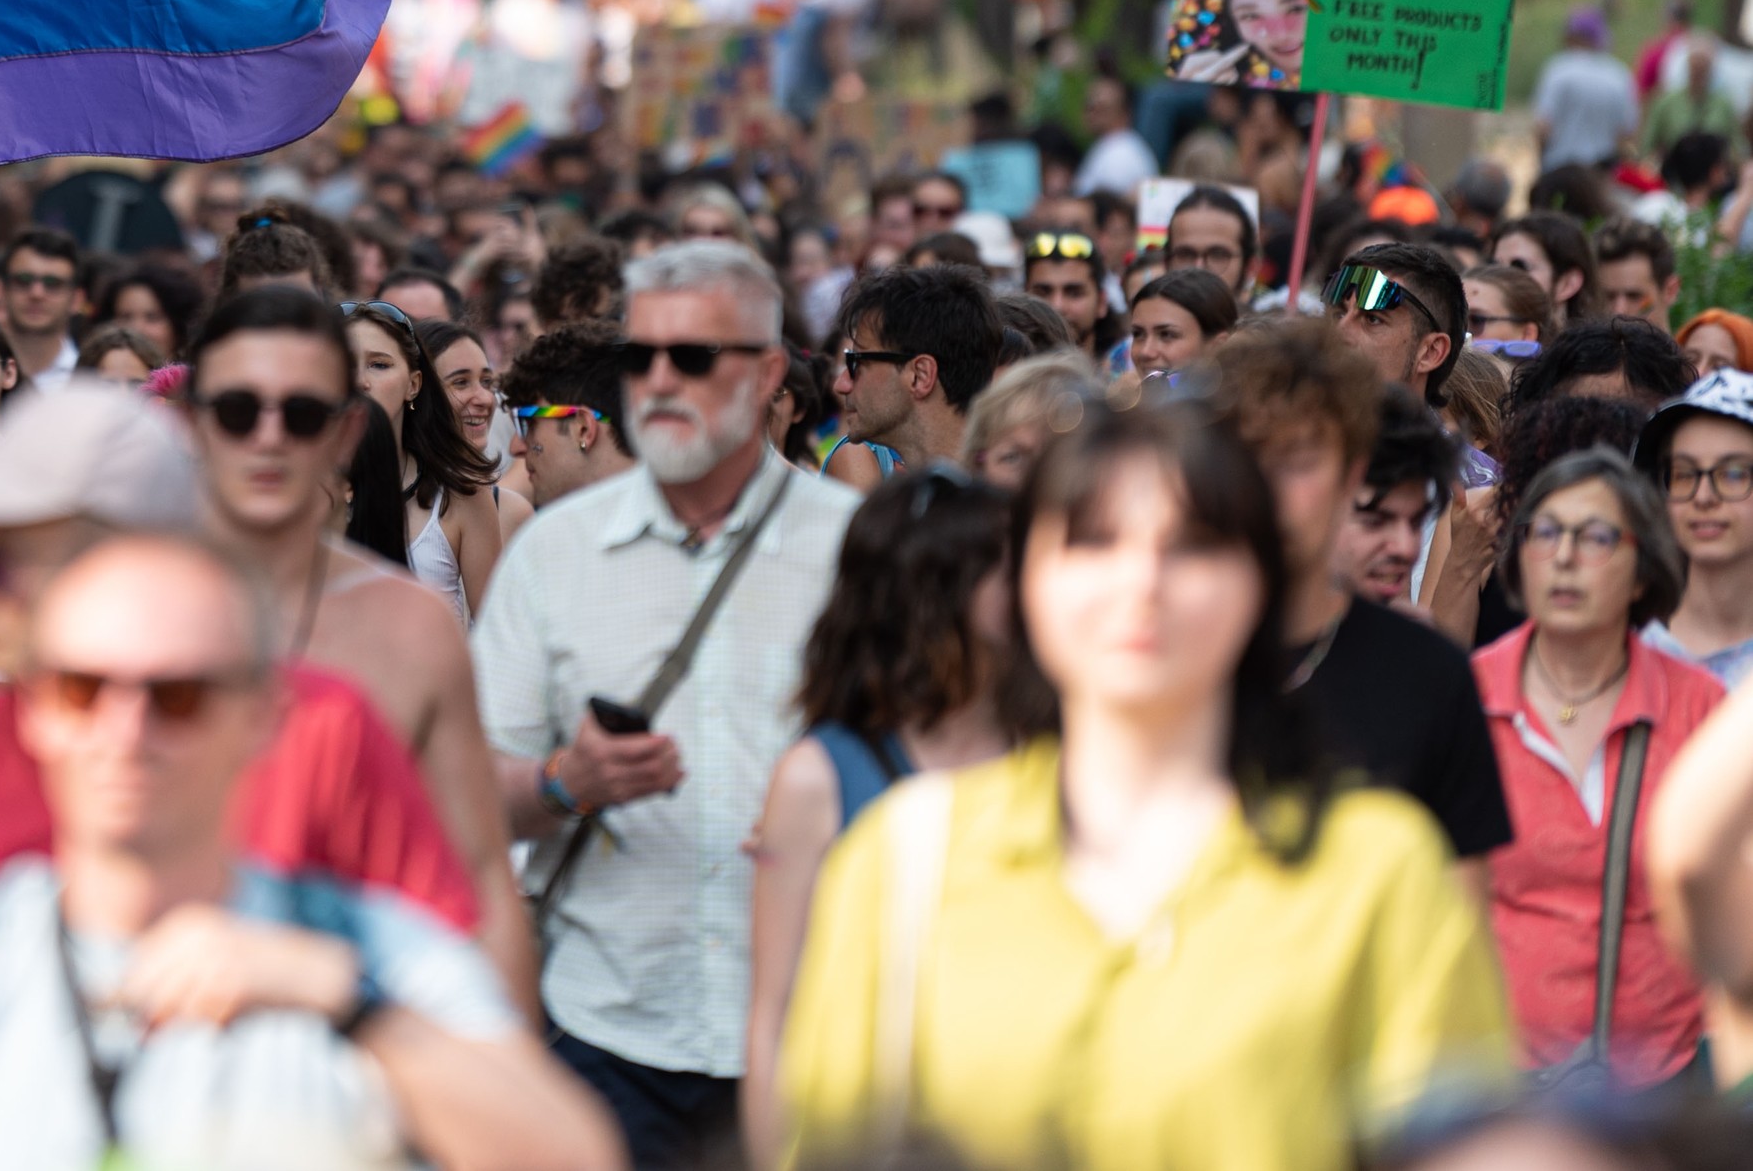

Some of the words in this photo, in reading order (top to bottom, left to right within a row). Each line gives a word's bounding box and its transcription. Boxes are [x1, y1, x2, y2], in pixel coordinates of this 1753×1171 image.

[1394, 7, 1482, 32] PRODUCTS
[1329, 27, 1383, 46] ONLY
[1395, 30, 1438, 52] THIS
